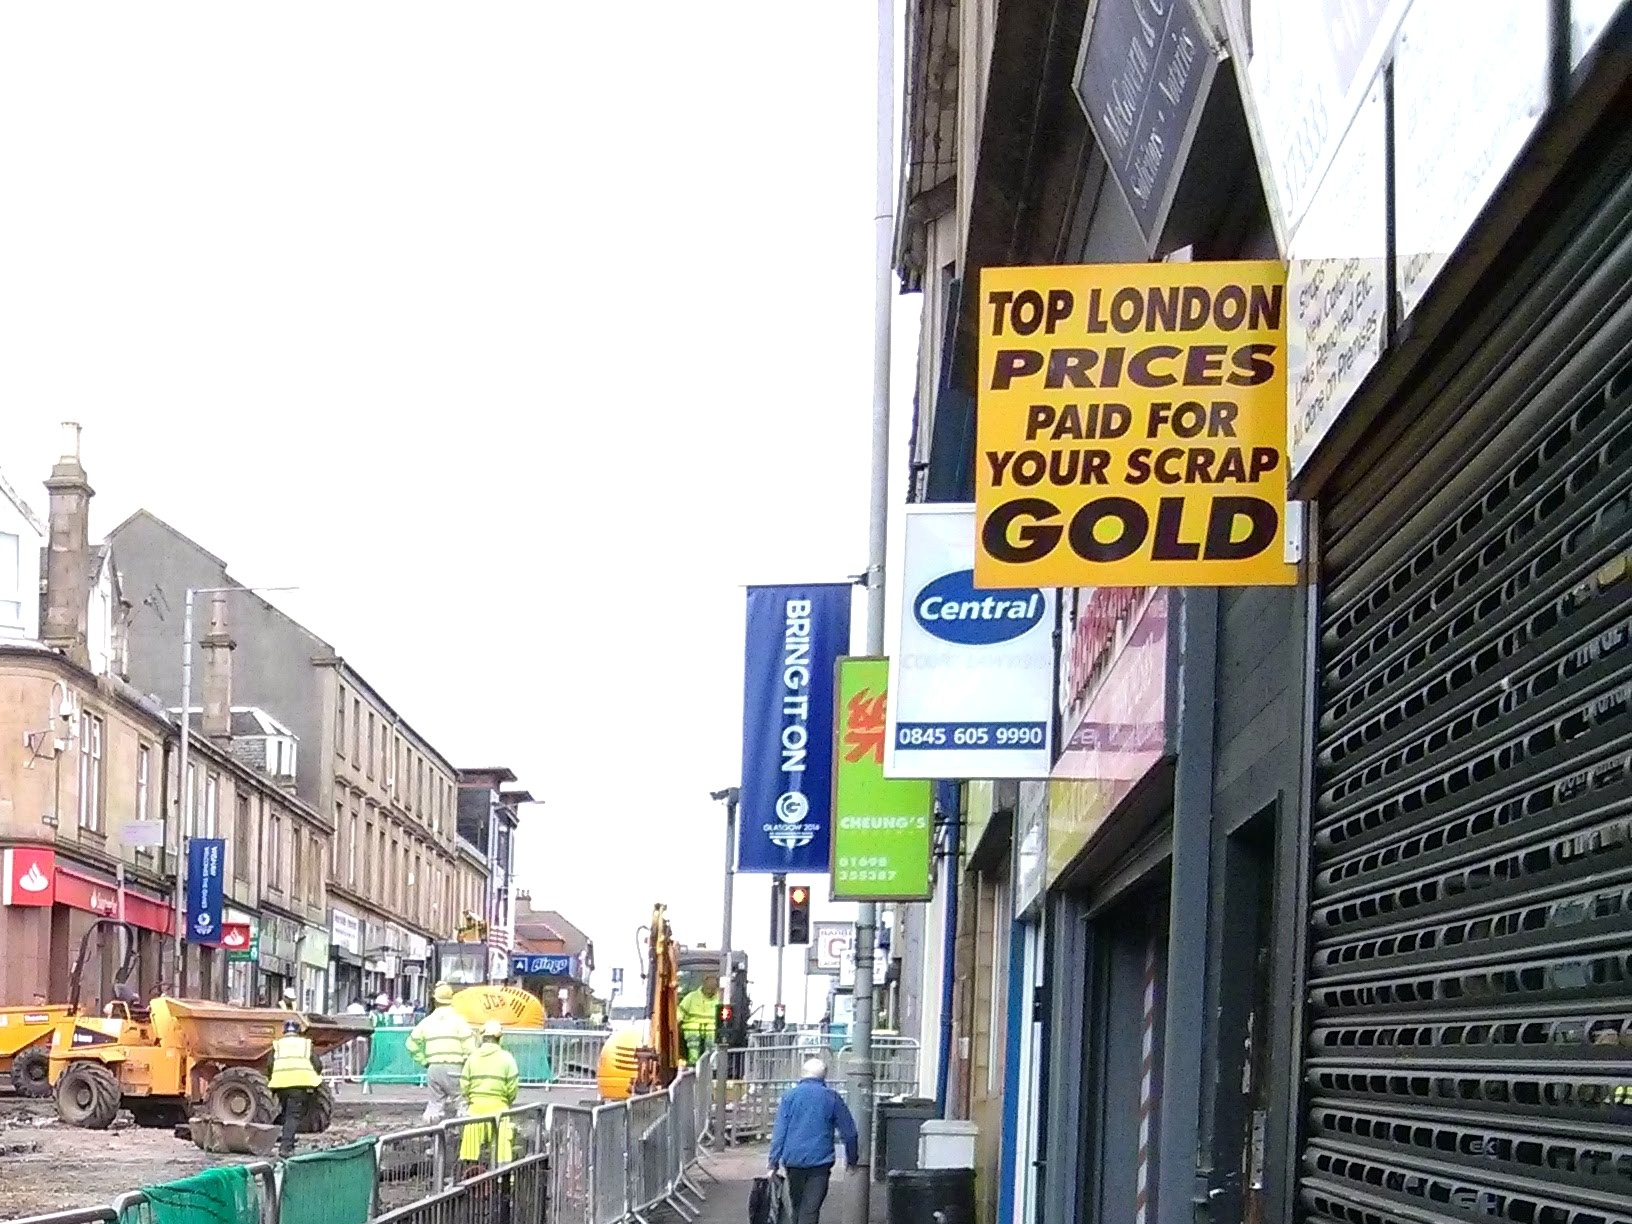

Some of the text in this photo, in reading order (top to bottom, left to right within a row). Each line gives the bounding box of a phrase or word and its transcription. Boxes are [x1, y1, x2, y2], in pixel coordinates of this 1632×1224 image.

[1130, 129, 1165, 209] Solicitors
[989, 284, 1284, 337] TOP LONDON
[990, 343, 1278, 391] PRICES
[1025, 401, 1240, 441] PAID FOR
[985, 446, 1280, 487] YOUR SCRAP
[982, 496, 1279, 564] GOLD
[919, 591, 1040, 621] Central
[781, 600, 811, 771] BRING IT ON
[899, 728, 1042, 744] 0845 605 9990
[762, 824, 802, 832] GLASGOW
[840, 816, 927, 830] CHEUNG'S
[838, 857, 888, 867] 01698
[483, 993, 507, 1010] JCB
